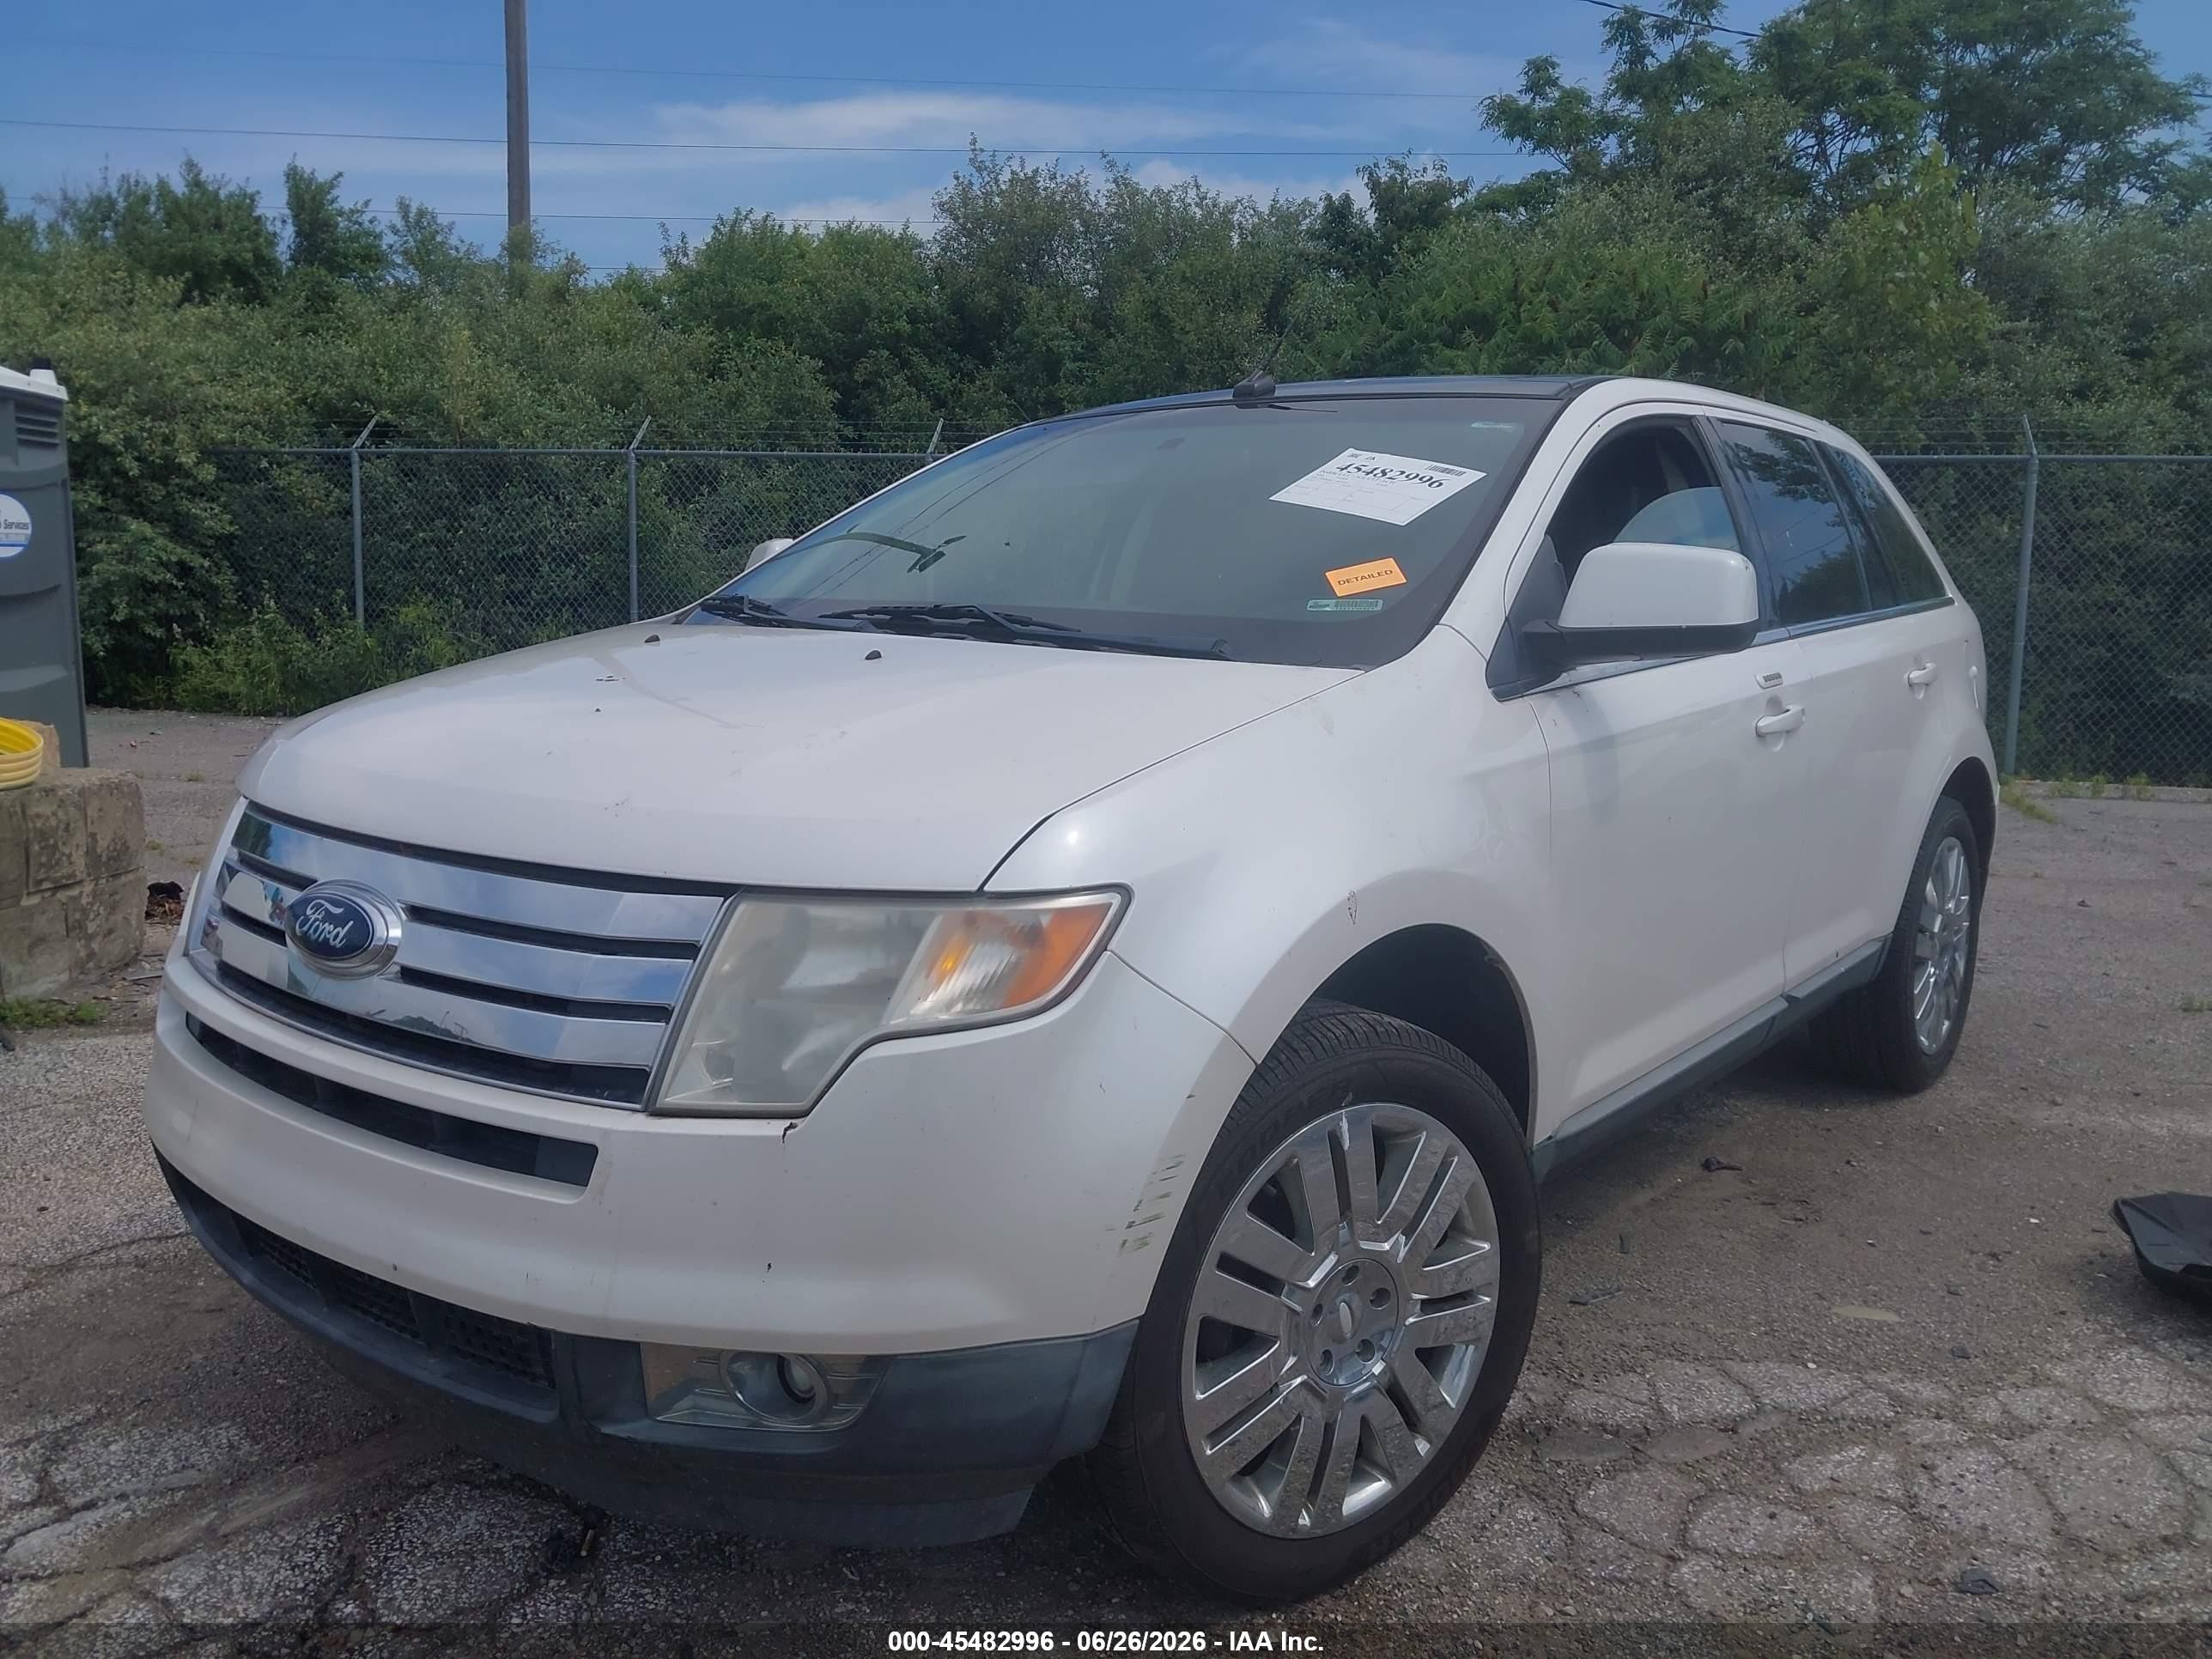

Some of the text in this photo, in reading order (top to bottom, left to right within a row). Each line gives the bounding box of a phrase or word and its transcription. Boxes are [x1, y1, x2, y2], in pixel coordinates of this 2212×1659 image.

[1336, 462, 1450, 489] 45482996
[3, 519, 29, 530] Services
[1338, 568, 1394, 586] DETAILED
[295, 899, 354, 948] Ford
